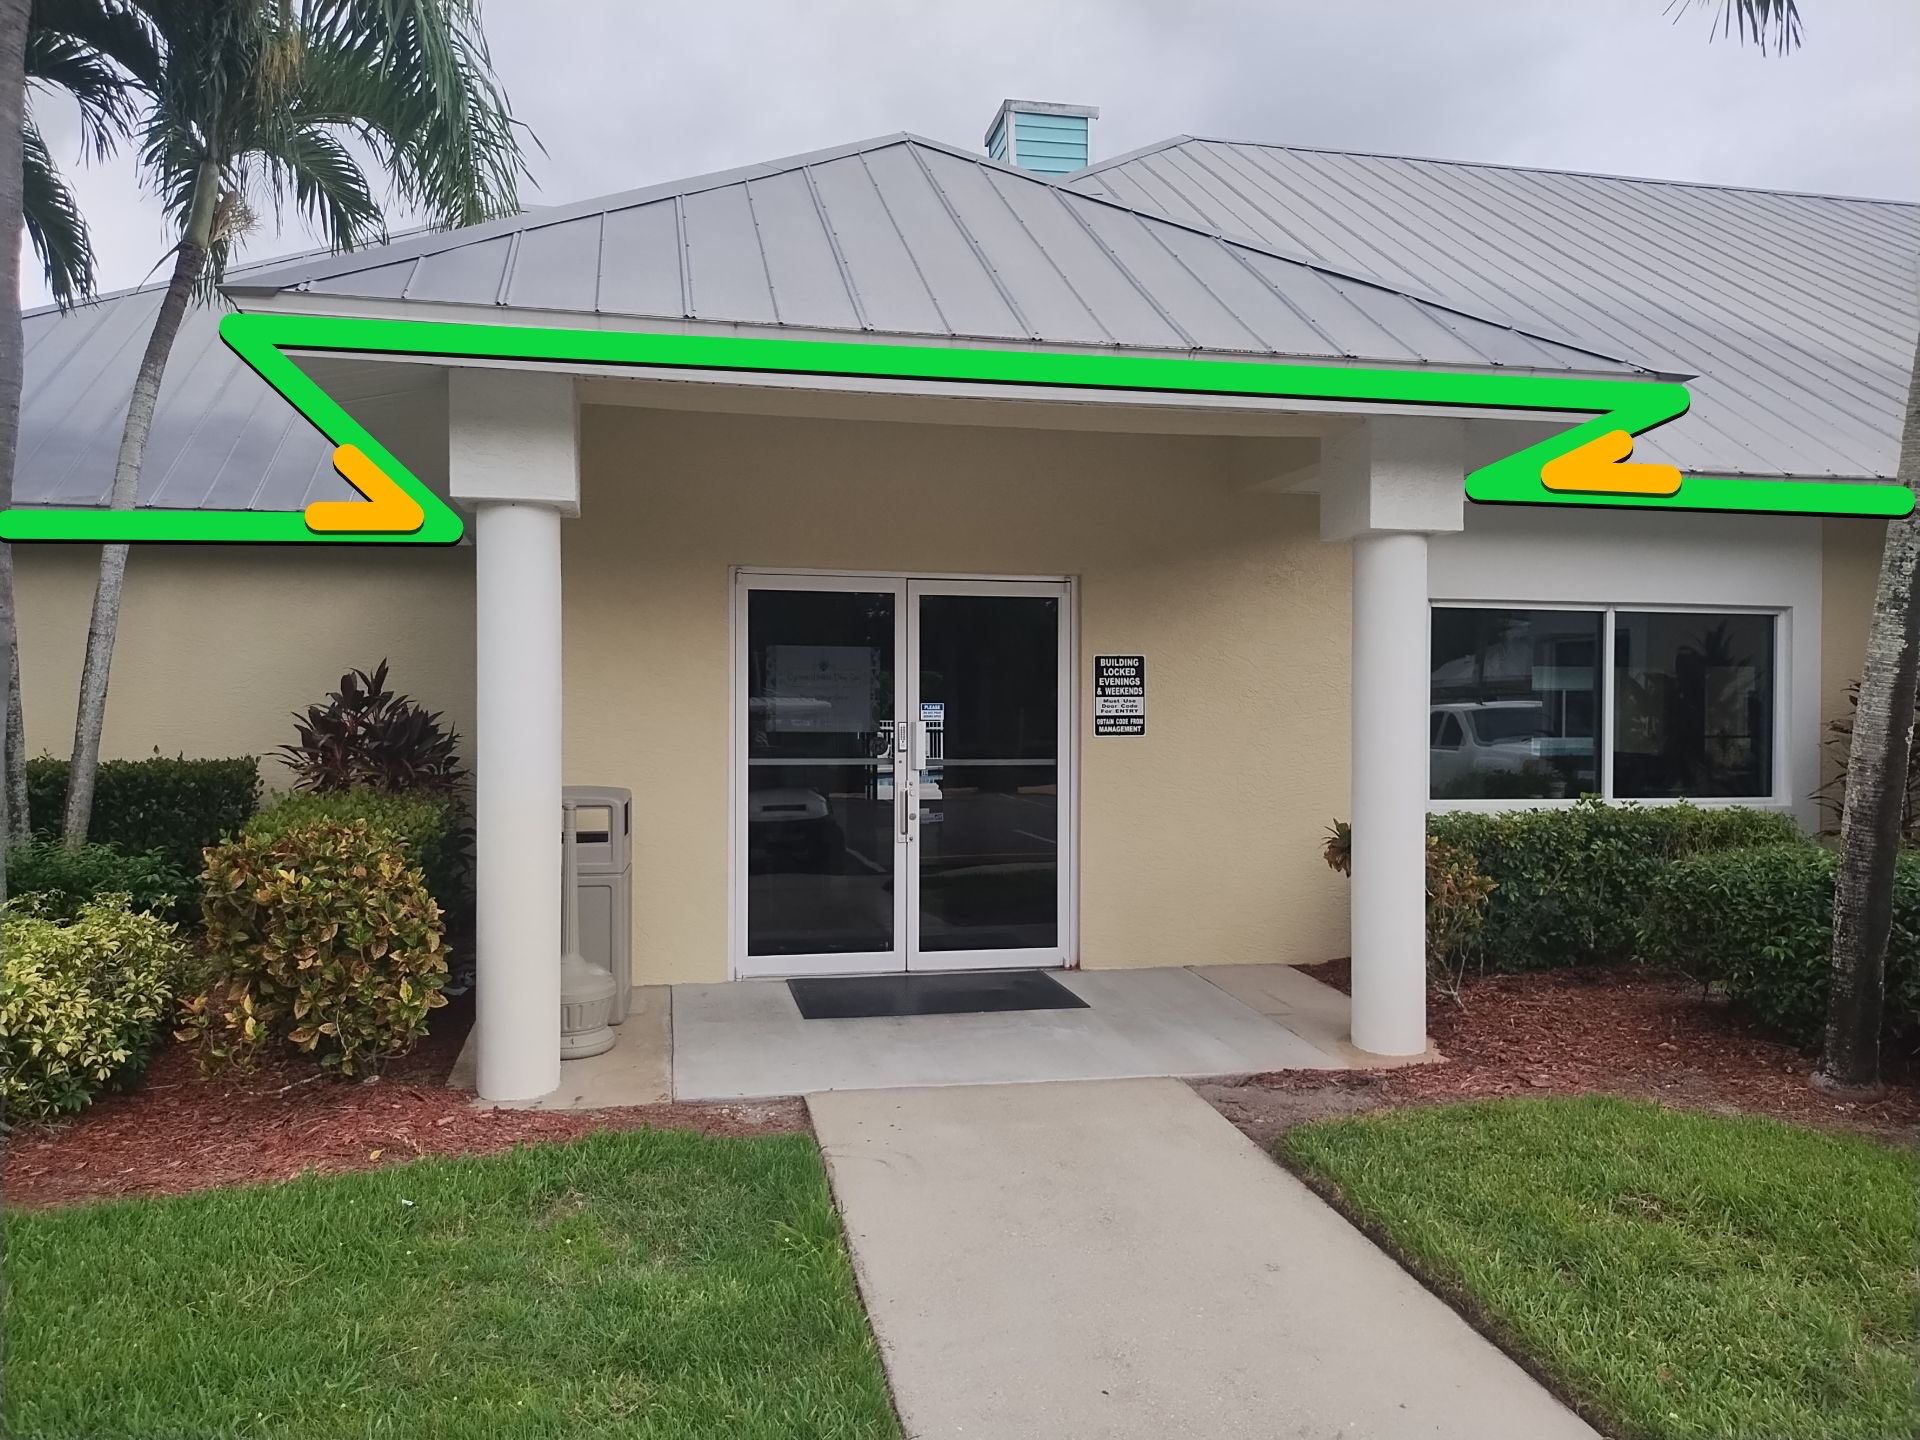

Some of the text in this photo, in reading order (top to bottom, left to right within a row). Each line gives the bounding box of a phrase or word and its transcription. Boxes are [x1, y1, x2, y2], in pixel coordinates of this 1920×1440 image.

[1100, 658, 1139, 667] BUILDING
[1103, 667, 1136, 676] LOCKED
[1099, 677, 1141, 686] EVENINGS
[1096, 687, 1143, 695] & WEEKENDS
[1098, 725, 1142, 733] MANAGEMENT
